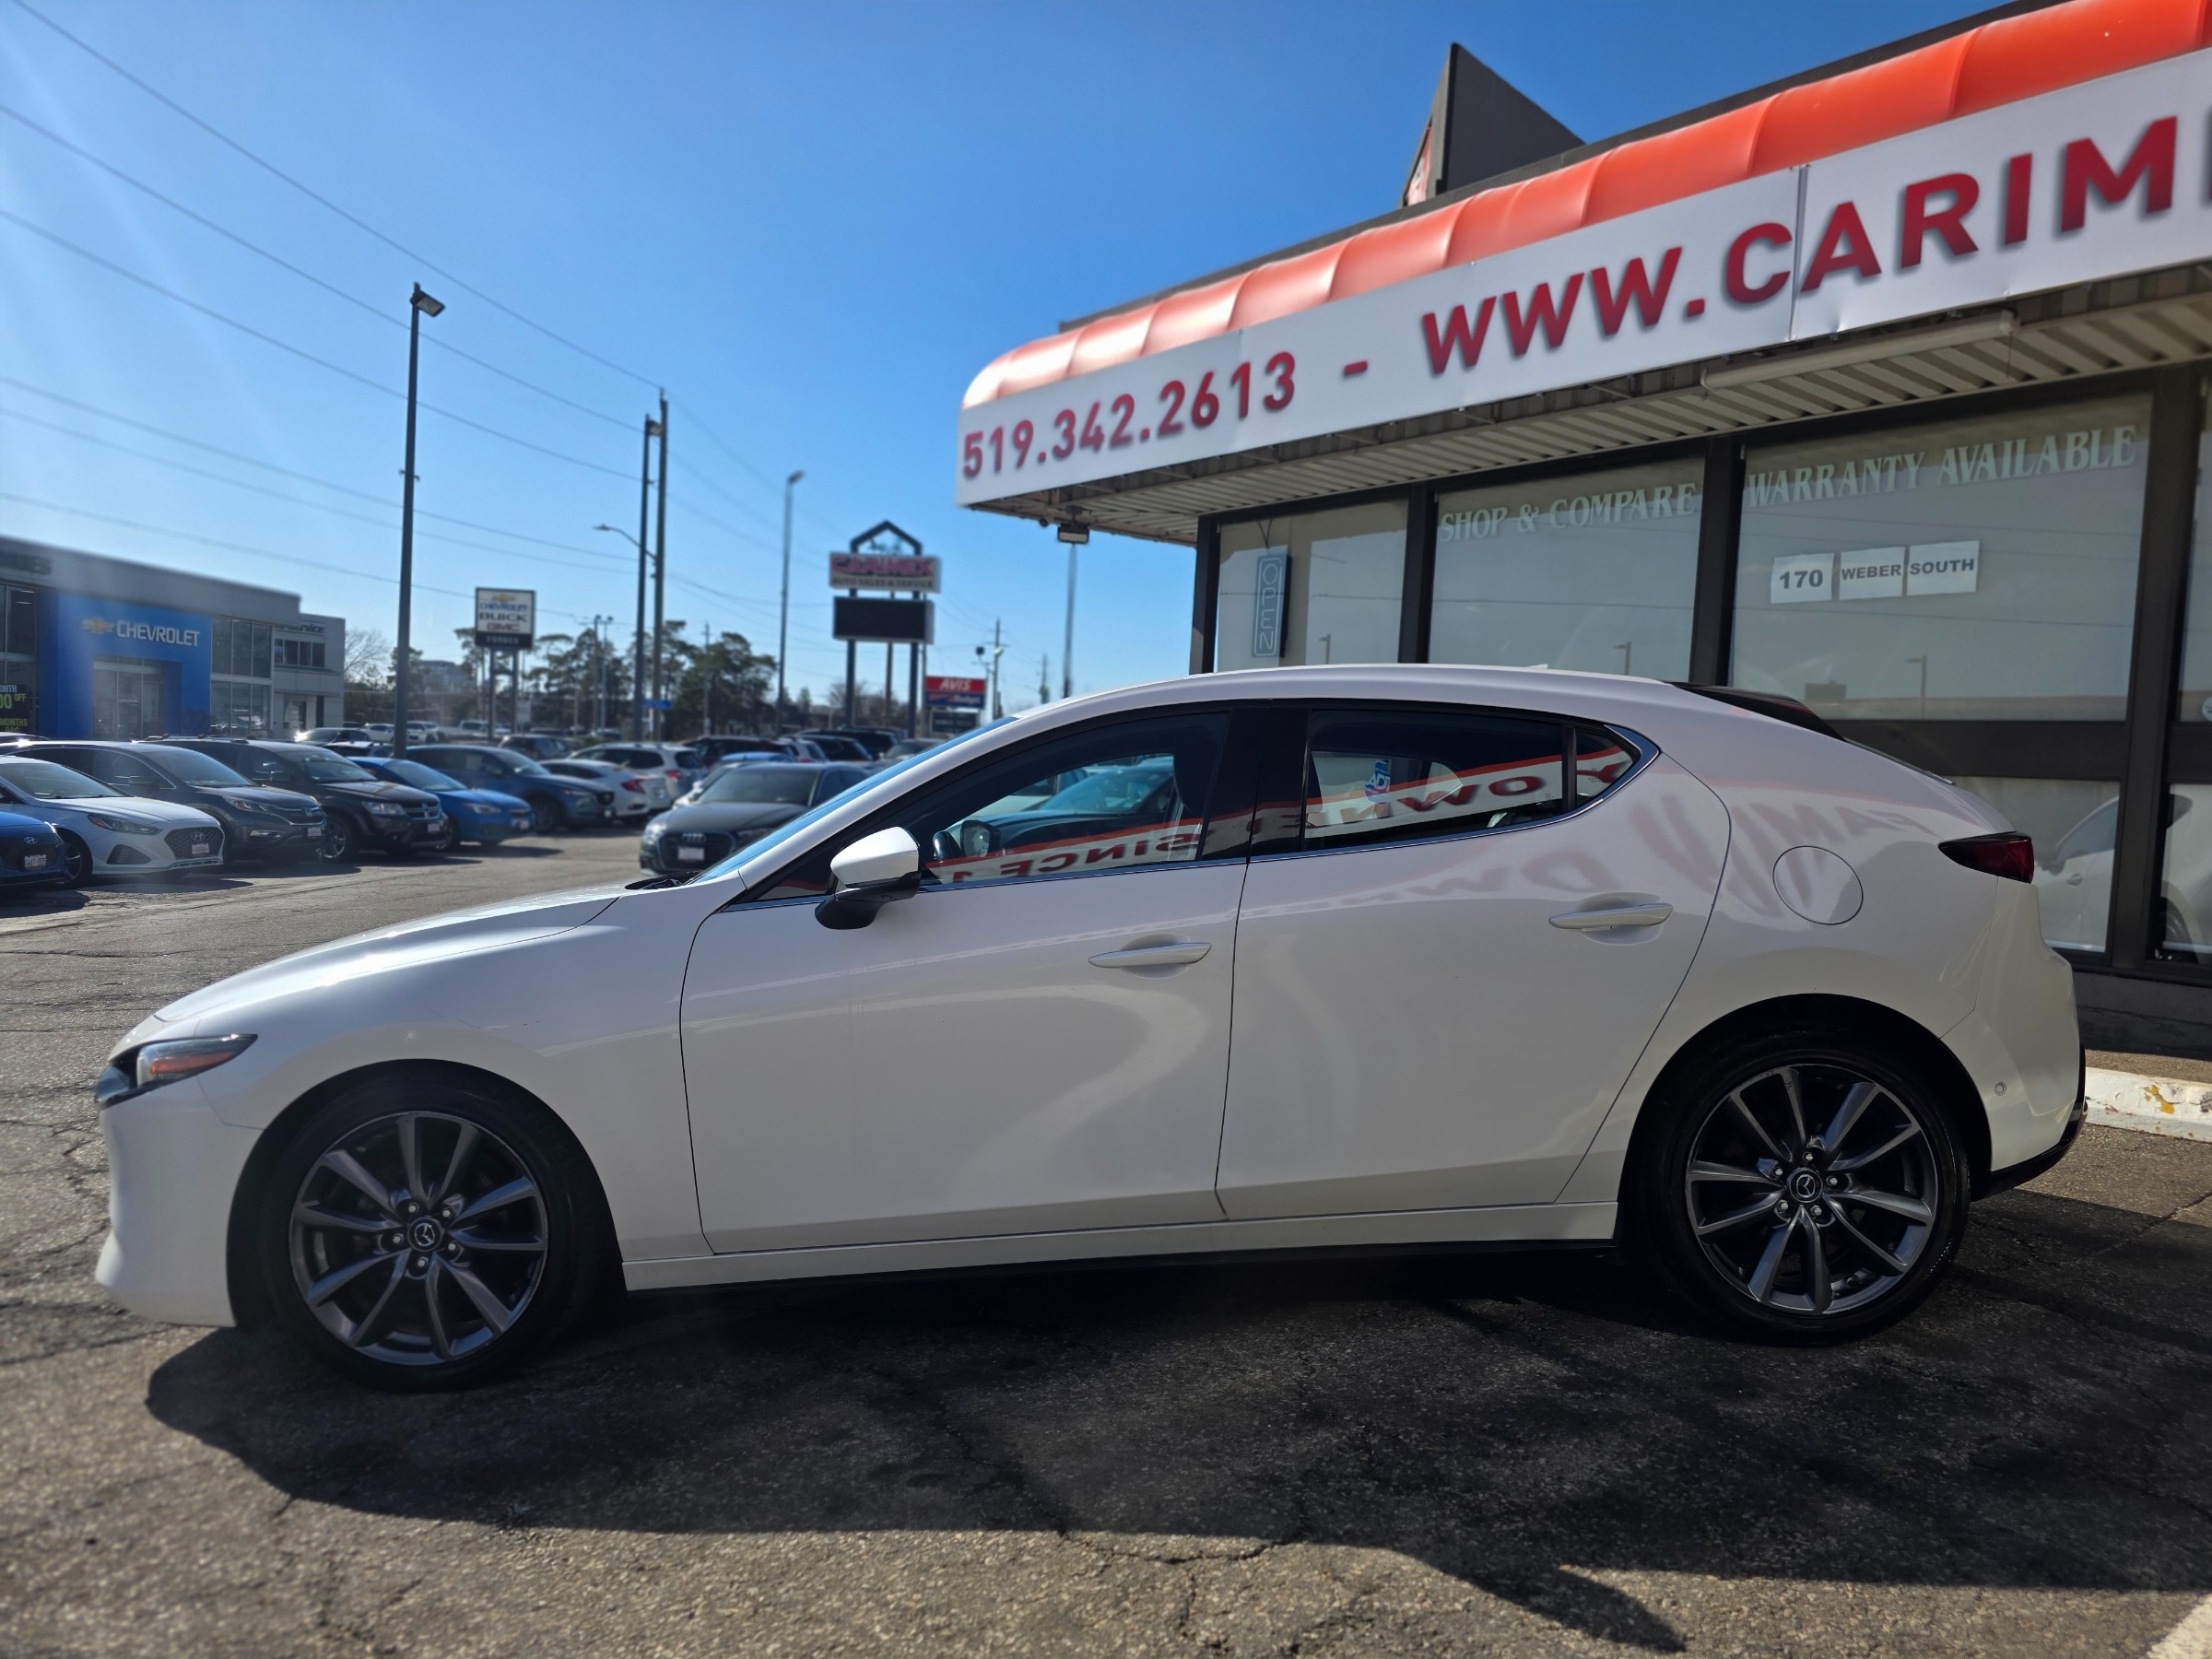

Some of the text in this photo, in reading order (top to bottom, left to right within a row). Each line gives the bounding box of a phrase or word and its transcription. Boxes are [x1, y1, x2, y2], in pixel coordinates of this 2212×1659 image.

[963, 351, 1296, 478] 519.342.2613
[1421, 106, 2212, 375] WWW.CARIM
[1747, 425, 2137, 508] WARRANTY AVAILABLE
[1439, 482, 1698, 544] SHOP & COMPARE
[1779, 559, 1975, 590] 170 WEBER SOUTH
[479, 611, 528, 623] BUICK
[1259, 563, 1279, 651] OPEN
[116, 620, 201, 647] CHEVROLET
[0, 684, 18, 692] ONTH
[14, 693, 26, 701] OFF
[939, 678, 971, 691] AVIS
